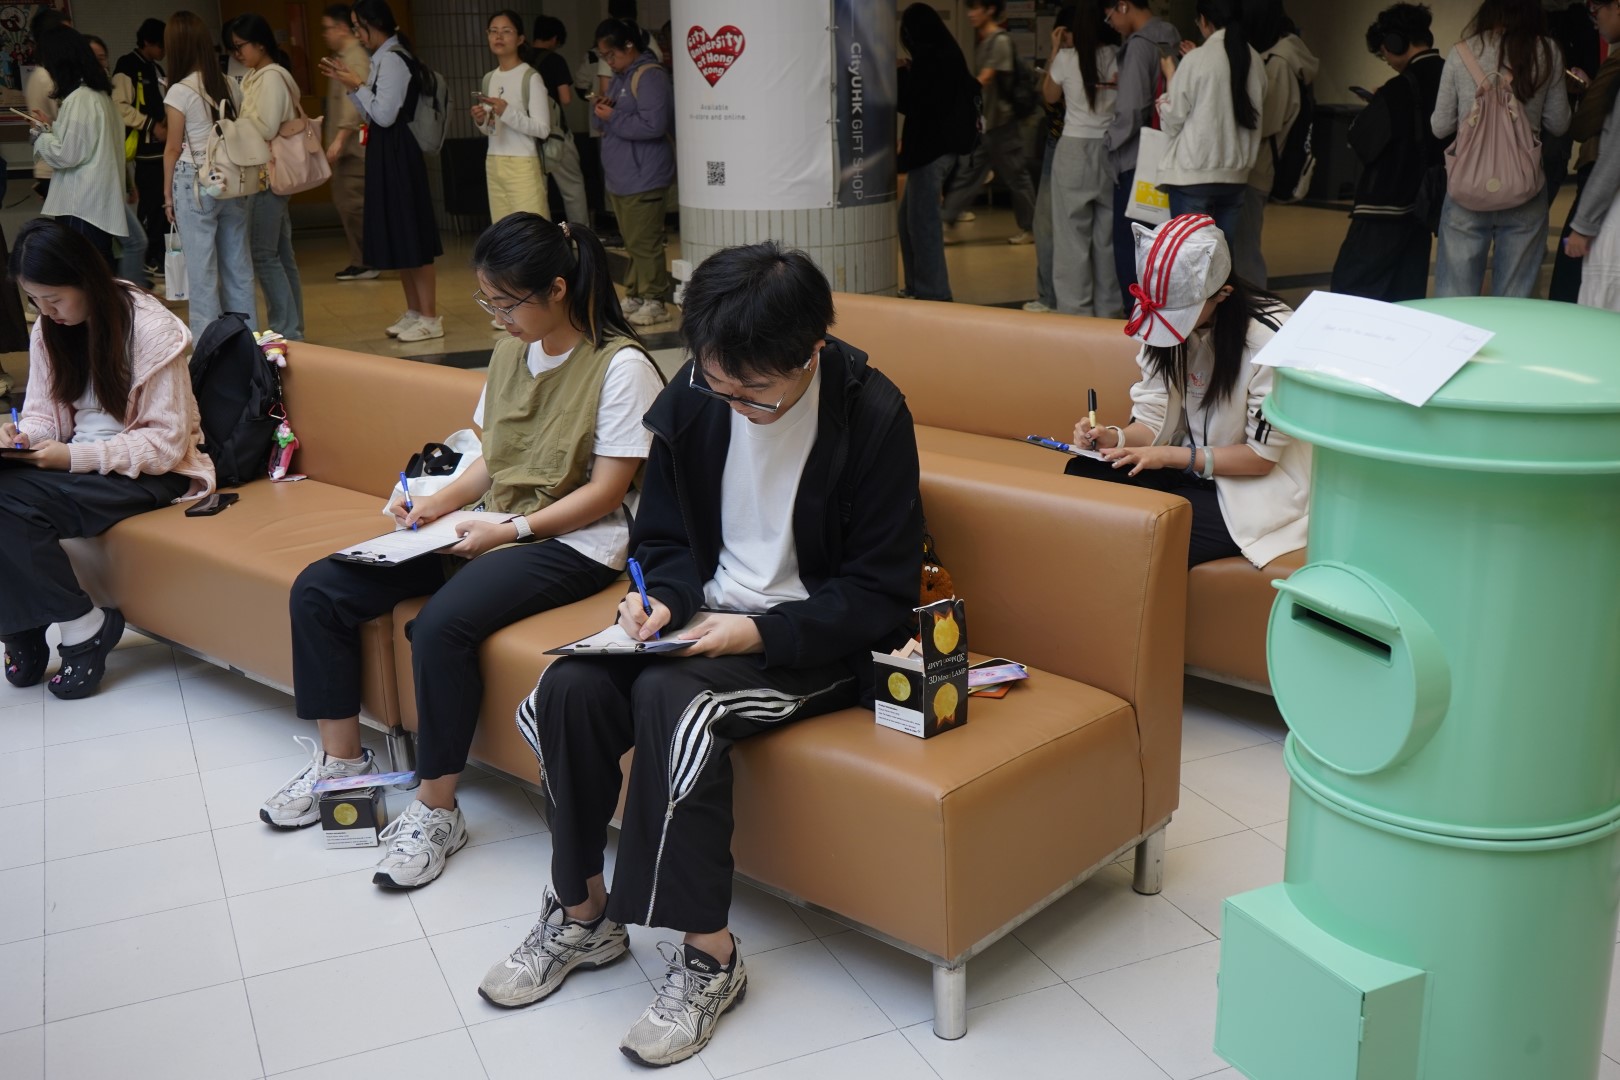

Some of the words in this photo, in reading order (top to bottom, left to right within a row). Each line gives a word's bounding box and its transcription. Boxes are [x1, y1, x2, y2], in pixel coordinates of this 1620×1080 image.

[706, 52, 734, 66] Hong
[702, 66, 725, 76] Kong
[848, 42, 862, 115] CityUHK
[852, 119, 863, 151] GIFT
[852, 157, 864, 200] SHOP
[927, 659, 943, 670] LAMP
[956, 652, 965, 662] 3D
[928, 675, 937, 685] 3D
[951, 667, 966, 678] LAMP
